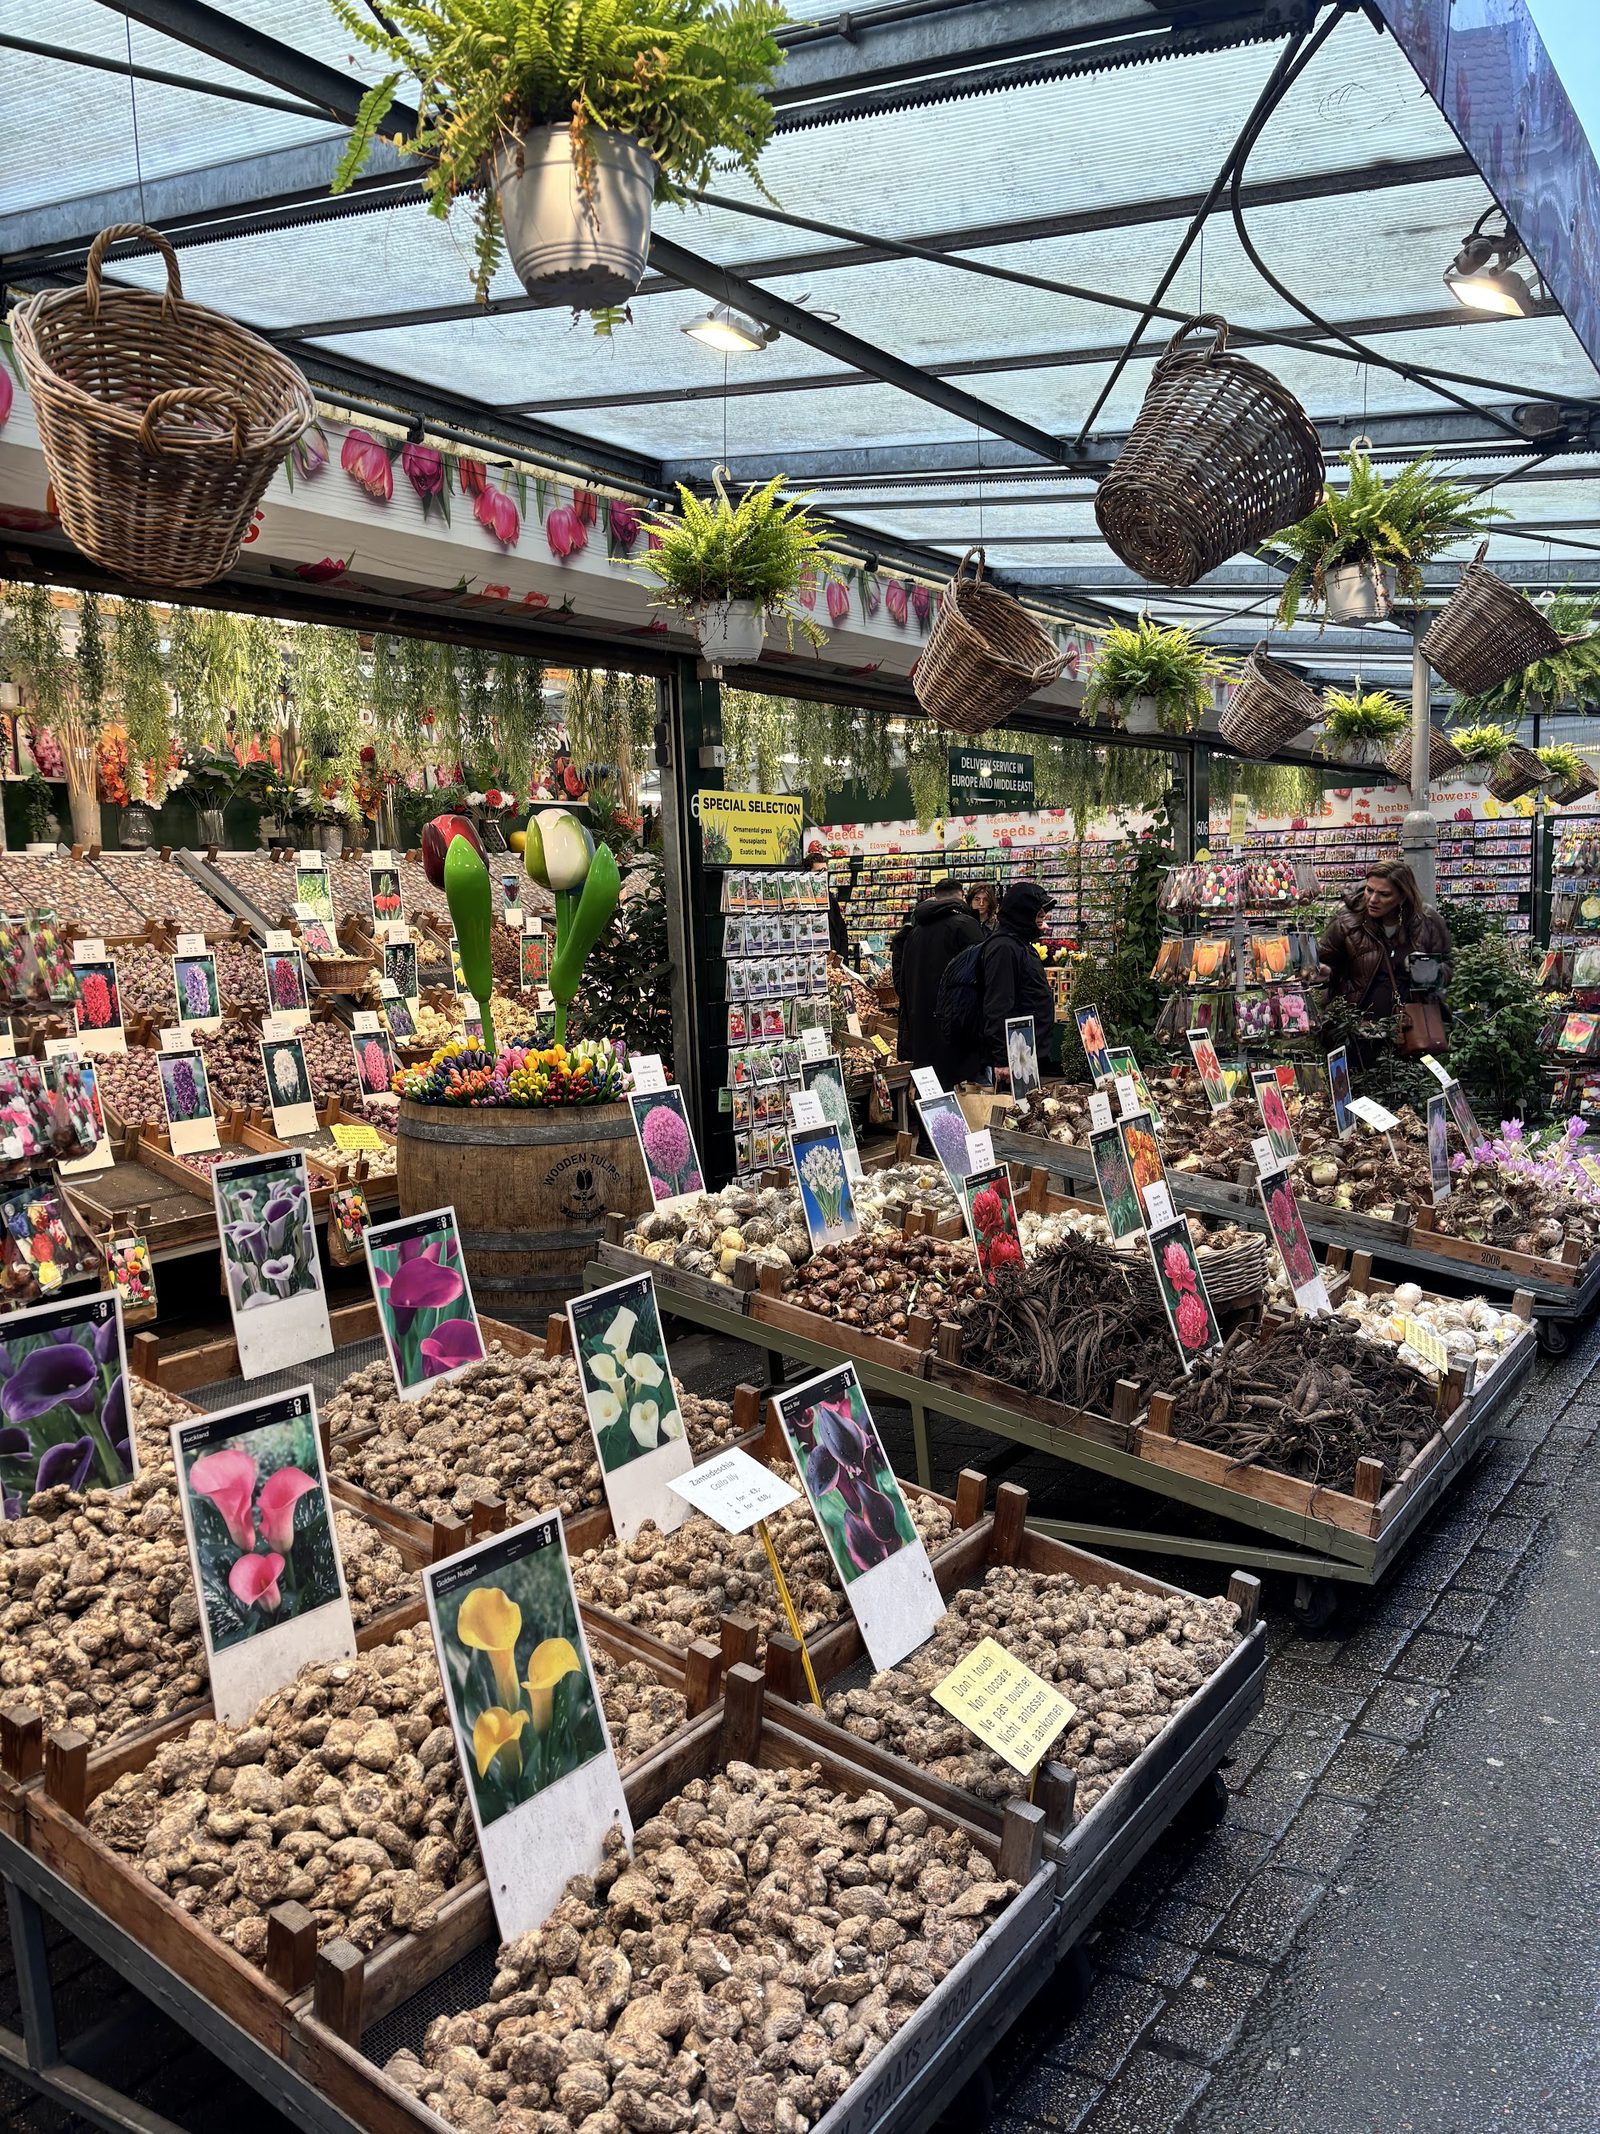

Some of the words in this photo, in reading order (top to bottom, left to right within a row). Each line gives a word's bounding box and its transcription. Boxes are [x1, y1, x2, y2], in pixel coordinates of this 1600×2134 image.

[961, 756, 992, 772] DELIVERY
[993, 760, 1017, 774] SERVICE
[1017, 763, 1024, 774] IN
[951, 774, 979, 788] EUROPE
[979, 777, 993, 789] AND
[994, 779, 1017, 791] MIDDLE
[1018, 781, 1034, 792] EAST!
[703, 797, 747, 811] SPECIAL
[748, 800, 801, 815] SELECTION
[1377, 803, 1409, 813] herbs
[733, 825, 760, 833] Ornamental
[827, 829, 864, 841] seeds
[992, 825, 1035, 839] seeds
[1196, 820, 1209, 836] 606
[740, 848, 754, 856] Exotic
[543, 1153, 587, 1186] WOODEN
[590, 1153, 620, 1181] TULIPS
[1480, 1252, 1500, 1266] 2006
[183, 1431, 210, 1444] Auckland
[689, 1460, 735, 1487] Zantedeschia
[735, 1494, 746, 1502] for
[436, 1575, 457, 1588] Golden
[457, 1564, 478, 1580] Nugget
[951, 1672, 976, 1697] Don't
[973, 1654, 995, 1678] touch
[966, 1695, 988, 1713] Non
[984, 1667, 1012, 1696] toccare
[978, 1719, 996, 1733] Ne
[993, 1702, 1009, 1722] pas
[1004, 1676, 1033, 1705] toucher
[996, 1722, 1021, 1746] Nicht
[1018, 1690, 1049, 1724] anfassen
[1014, 1740, 1036, 1761] Niet
[1032, 1703, 1065, 1742] aankomen
